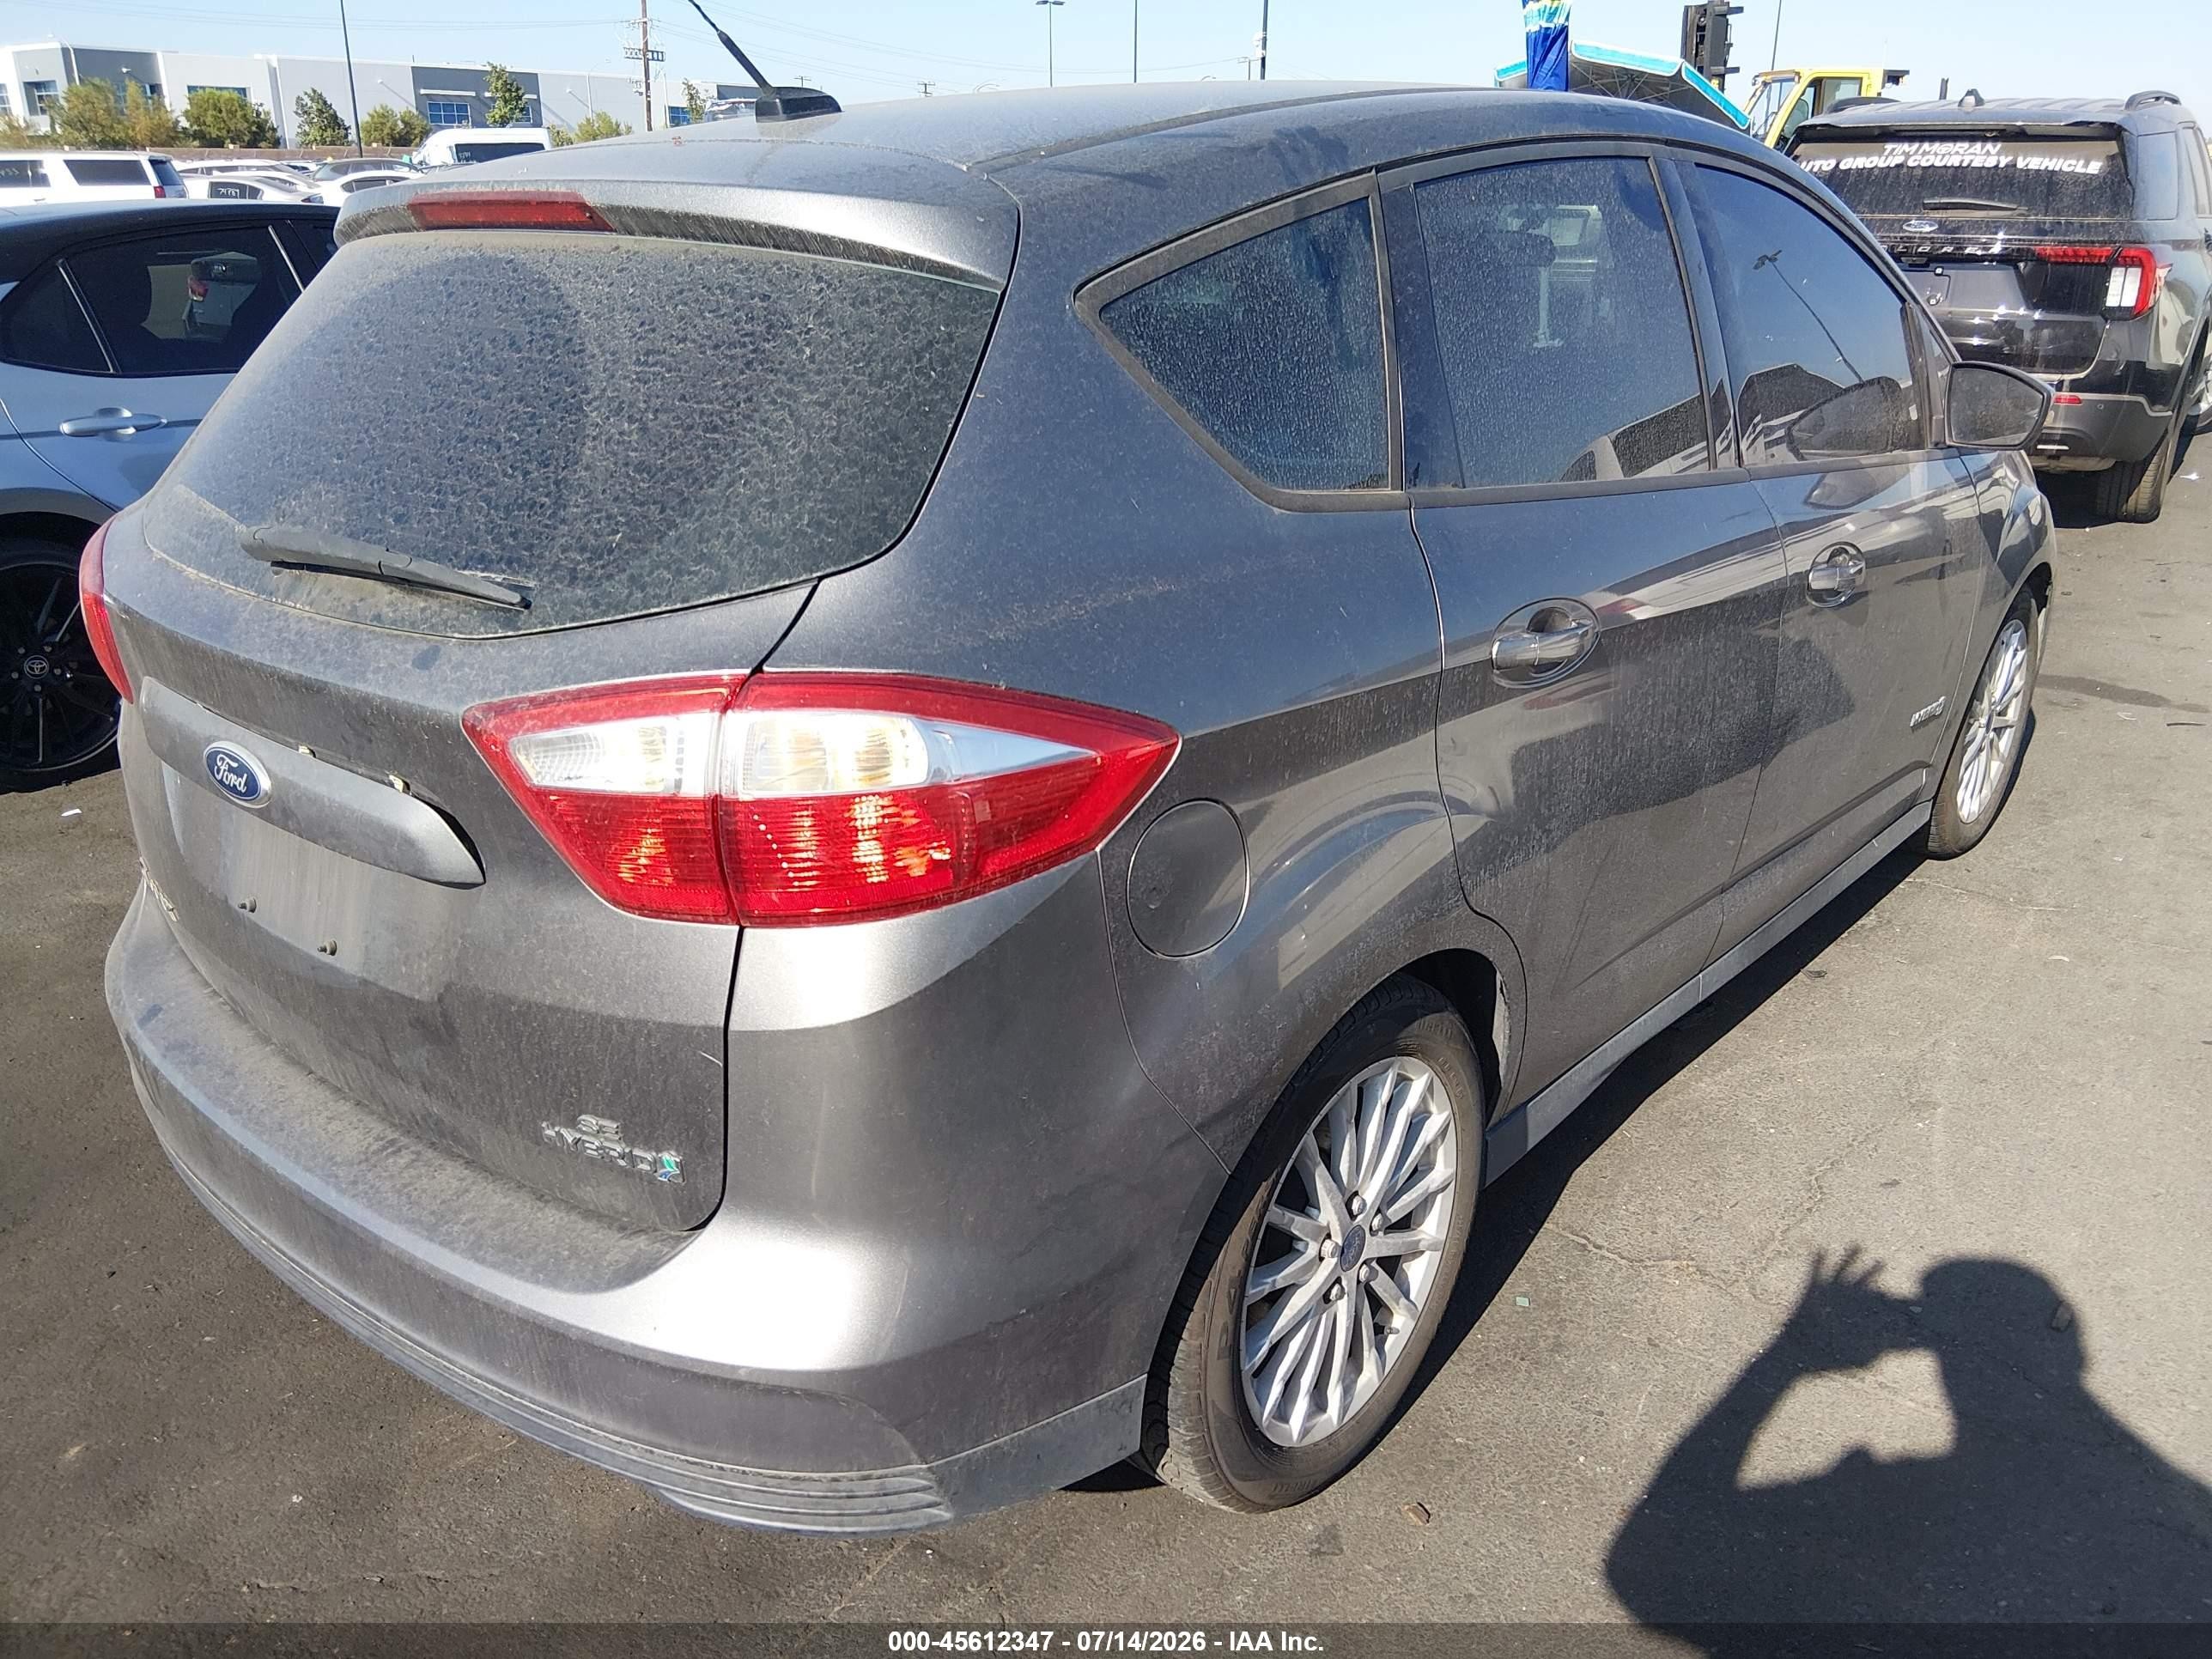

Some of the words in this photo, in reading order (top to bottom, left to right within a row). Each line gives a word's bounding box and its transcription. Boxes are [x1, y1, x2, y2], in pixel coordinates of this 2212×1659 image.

[1884, 143, 1916, 155] TIM
[1919, 142, 2002, 155] MORAN
[1800, 158, 1837, 173] UTO
[1838, 155, 1905, 170] GROUP
[1907, 155, 2014, 168] COURTESY
[2016, 156, 2103, 174] VEHICLE
[214, 753, 248, 793] Ford
